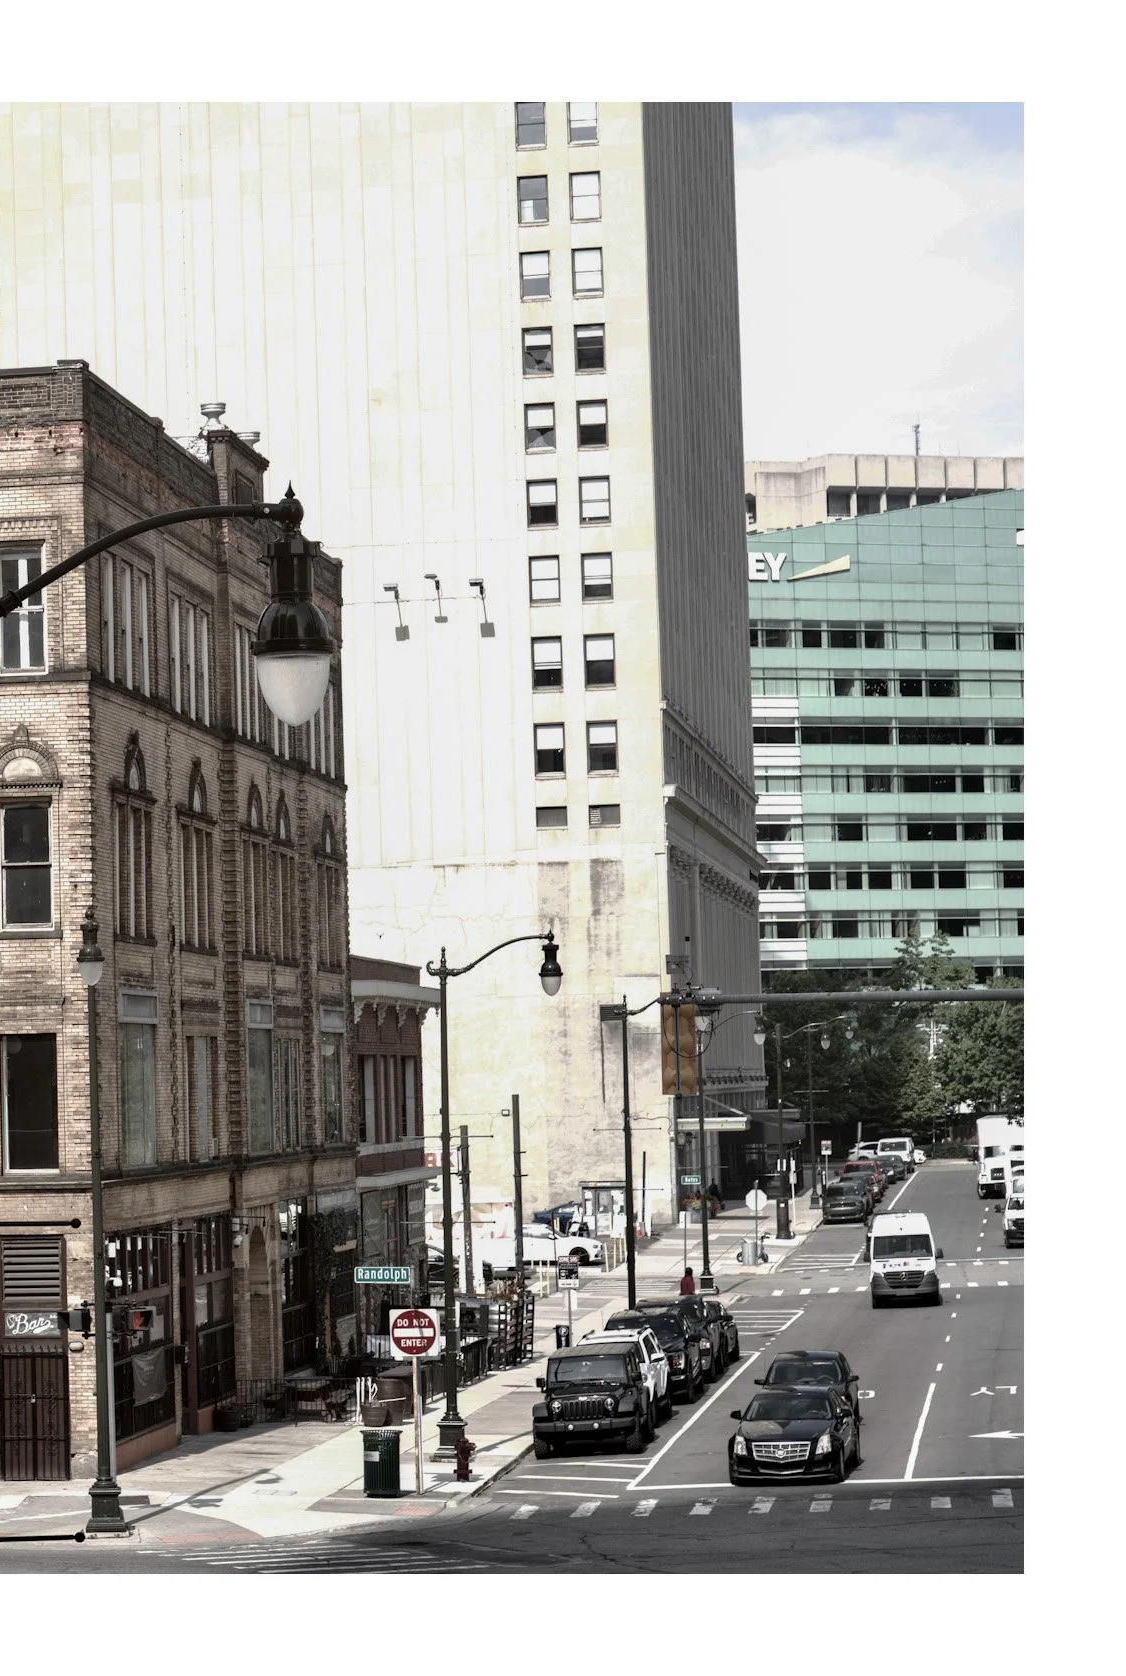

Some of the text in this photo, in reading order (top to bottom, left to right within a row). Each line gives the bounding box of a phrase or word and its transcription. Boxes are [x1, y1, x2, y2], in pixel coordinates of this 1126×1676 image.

[747, 552, 787, 581] EY
[357, 1268, 407, 1282] Randolph
[397, 1319, 430, 1327] DO NOT
[400, 1338, 427, 1347] ENTER
